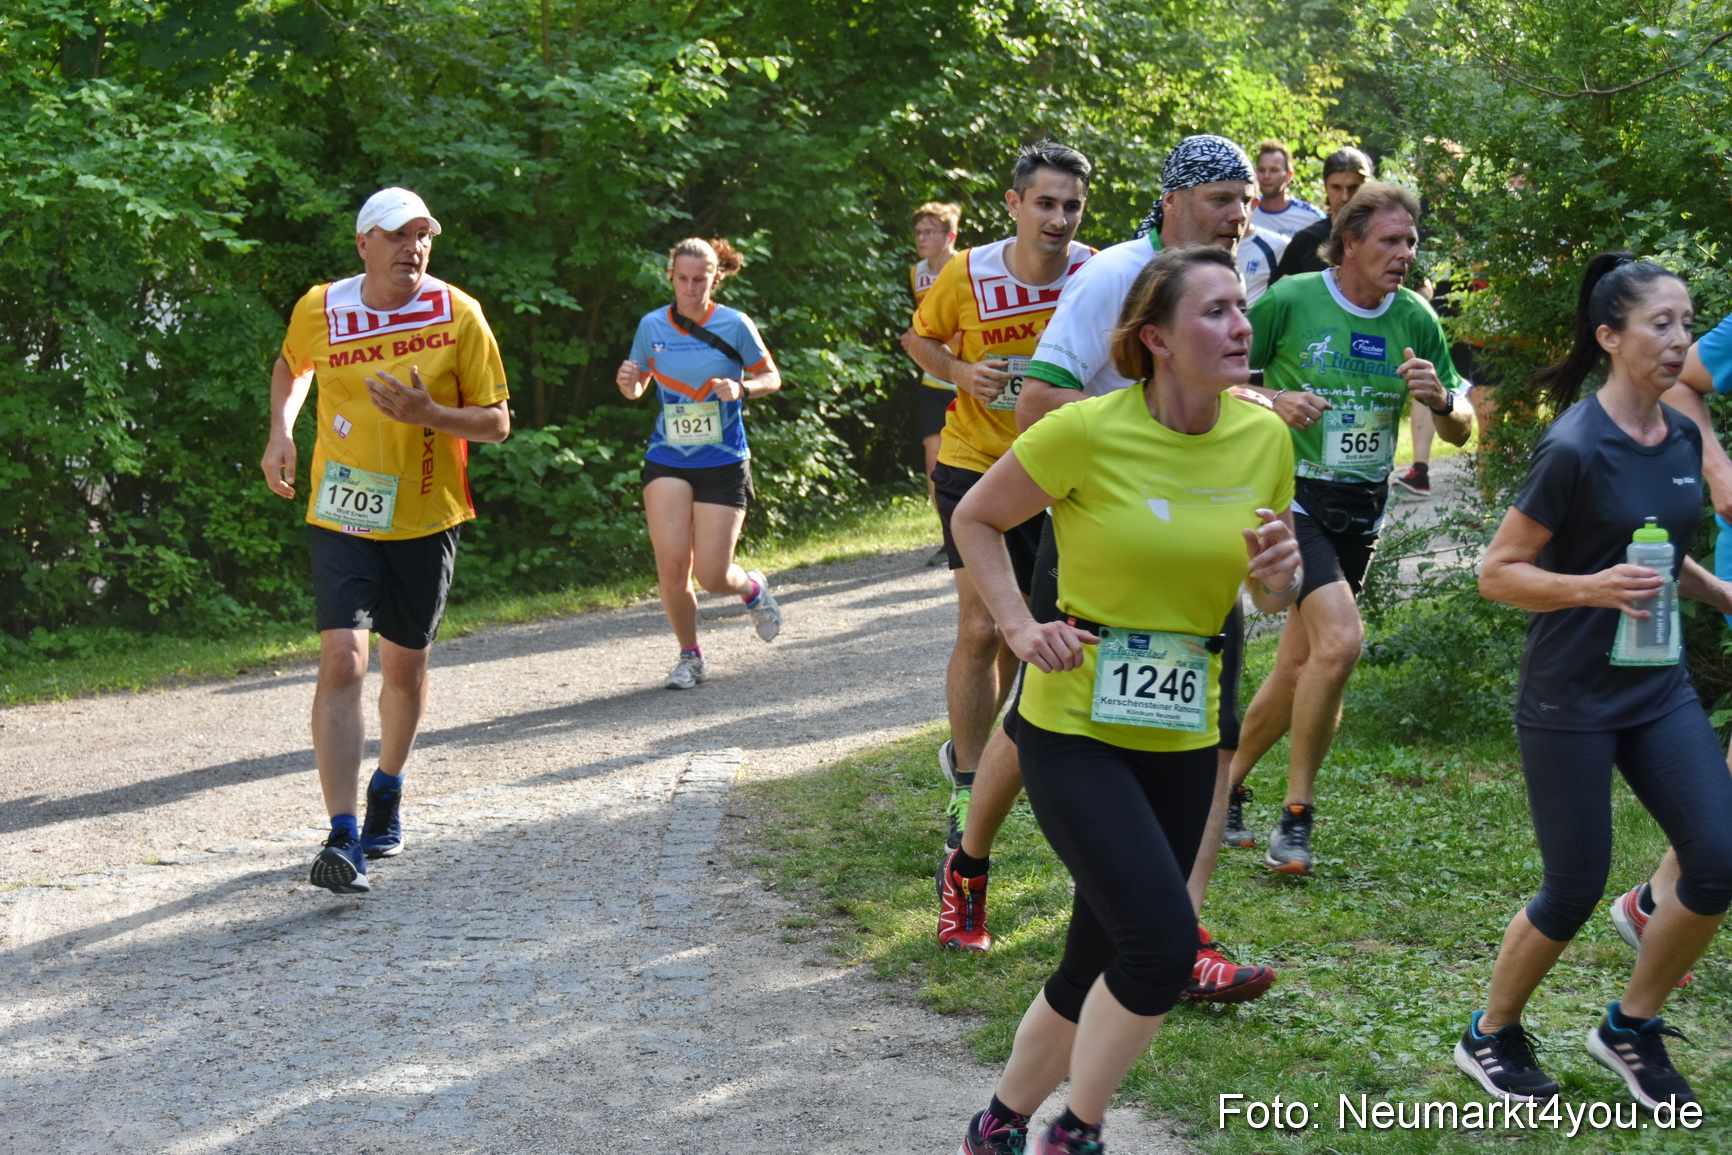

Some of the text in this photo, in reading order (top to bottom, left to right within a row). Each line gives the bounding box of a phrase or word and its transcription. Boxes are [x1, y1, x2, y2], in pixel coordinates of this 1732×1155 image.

[982, 322, 1037, 346] MAX
[328, 332, 456, 368] MAX BÖGL
[673, 418, 712, 434] 1921
[1340, 432, 1380, 454] 565
[329, 484, 384, 514] 1703
[351, 510, 368, 519] Erwin
[1113, 663, 1196, 704] 1246
[1100, 696, 1200, 714] Kerschensteiner Ramona
[1126, 708, 1154, 718] Klinikum
